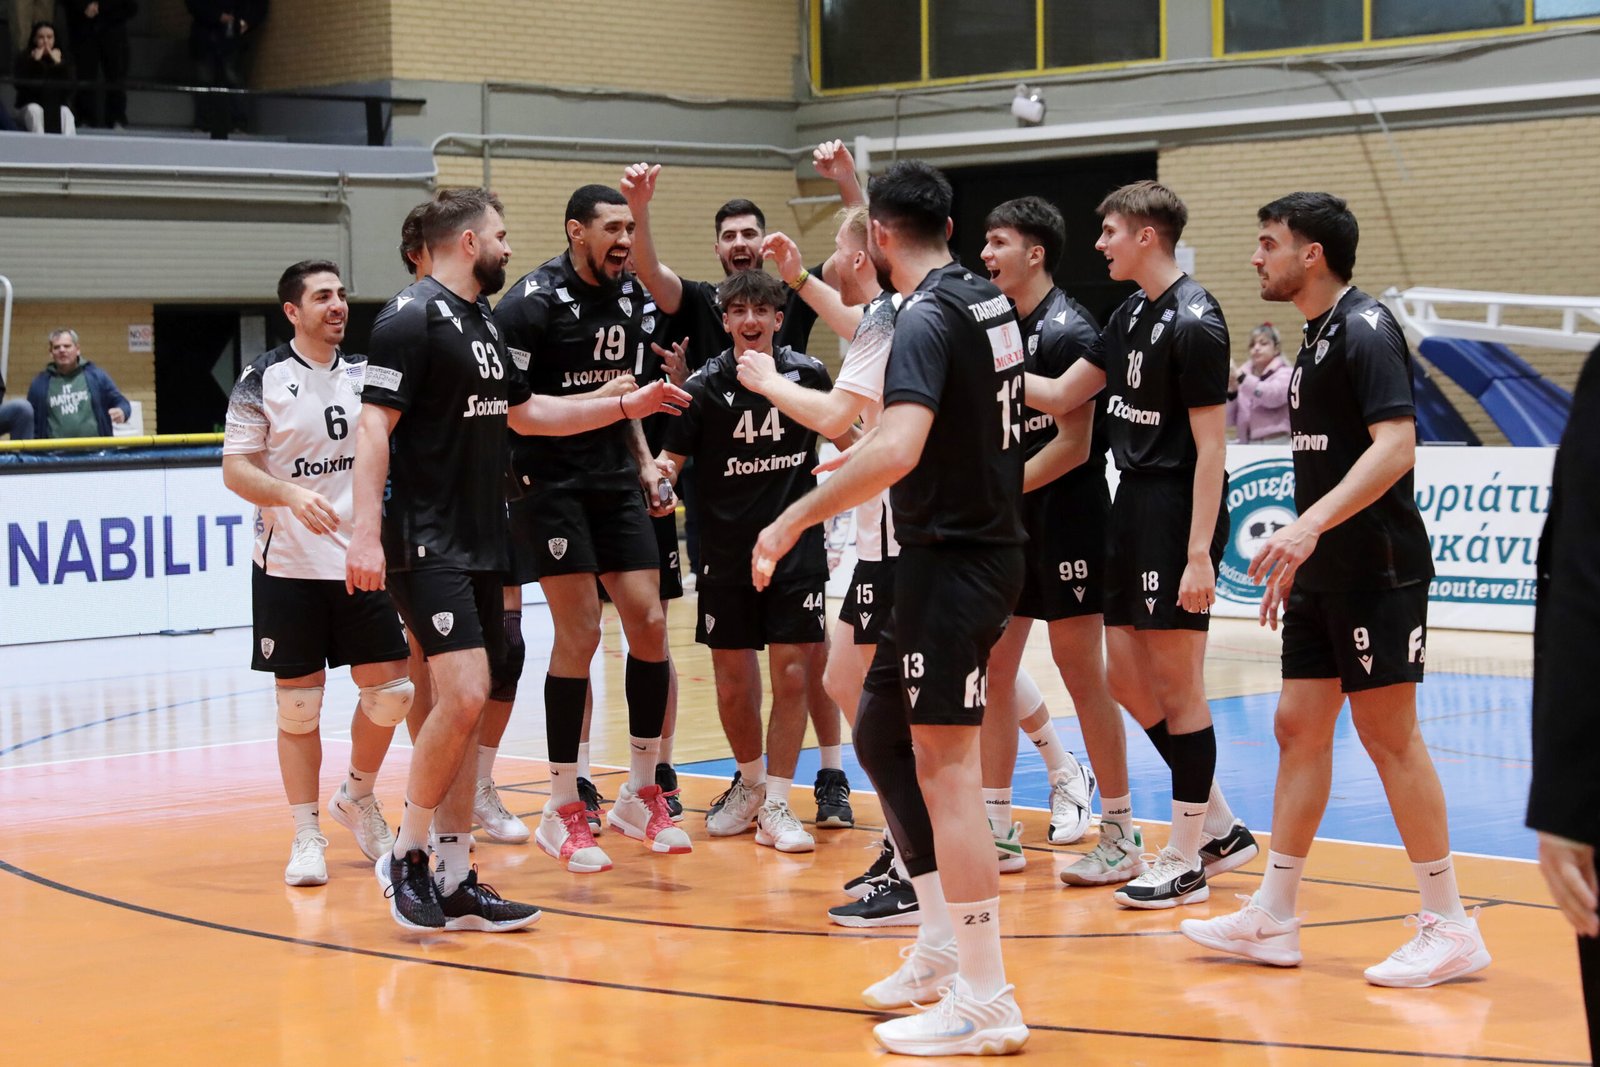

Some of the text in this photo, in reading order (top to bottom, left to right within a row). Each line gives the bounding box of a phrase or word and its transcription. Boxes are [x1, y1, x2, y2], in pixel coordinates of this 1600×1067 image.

[594, 325, 626, 361] 19
[471, 341, 504, 380] 93
[1127, 350, 1143, 389] 18
[62, 384, 72, 393] IT
[1291, 366, 1302, 410] 9
[61, 403, 79, 415] NOT
[324, 405, 348, 440] 6
[733, 407, 785, 444] 44
[8, 515, 242, 587] NABILIT
[1059, 559, 1089, 581] 99
[1141, 571, 1160, 592] 18
[803, 592, 823, 611] 44
[856, 584, 874, 605] 15
[1353, 627, 1370, 651] 9
[902, 652, 925, 679] 13
[963, 912, 991, 926] 23
